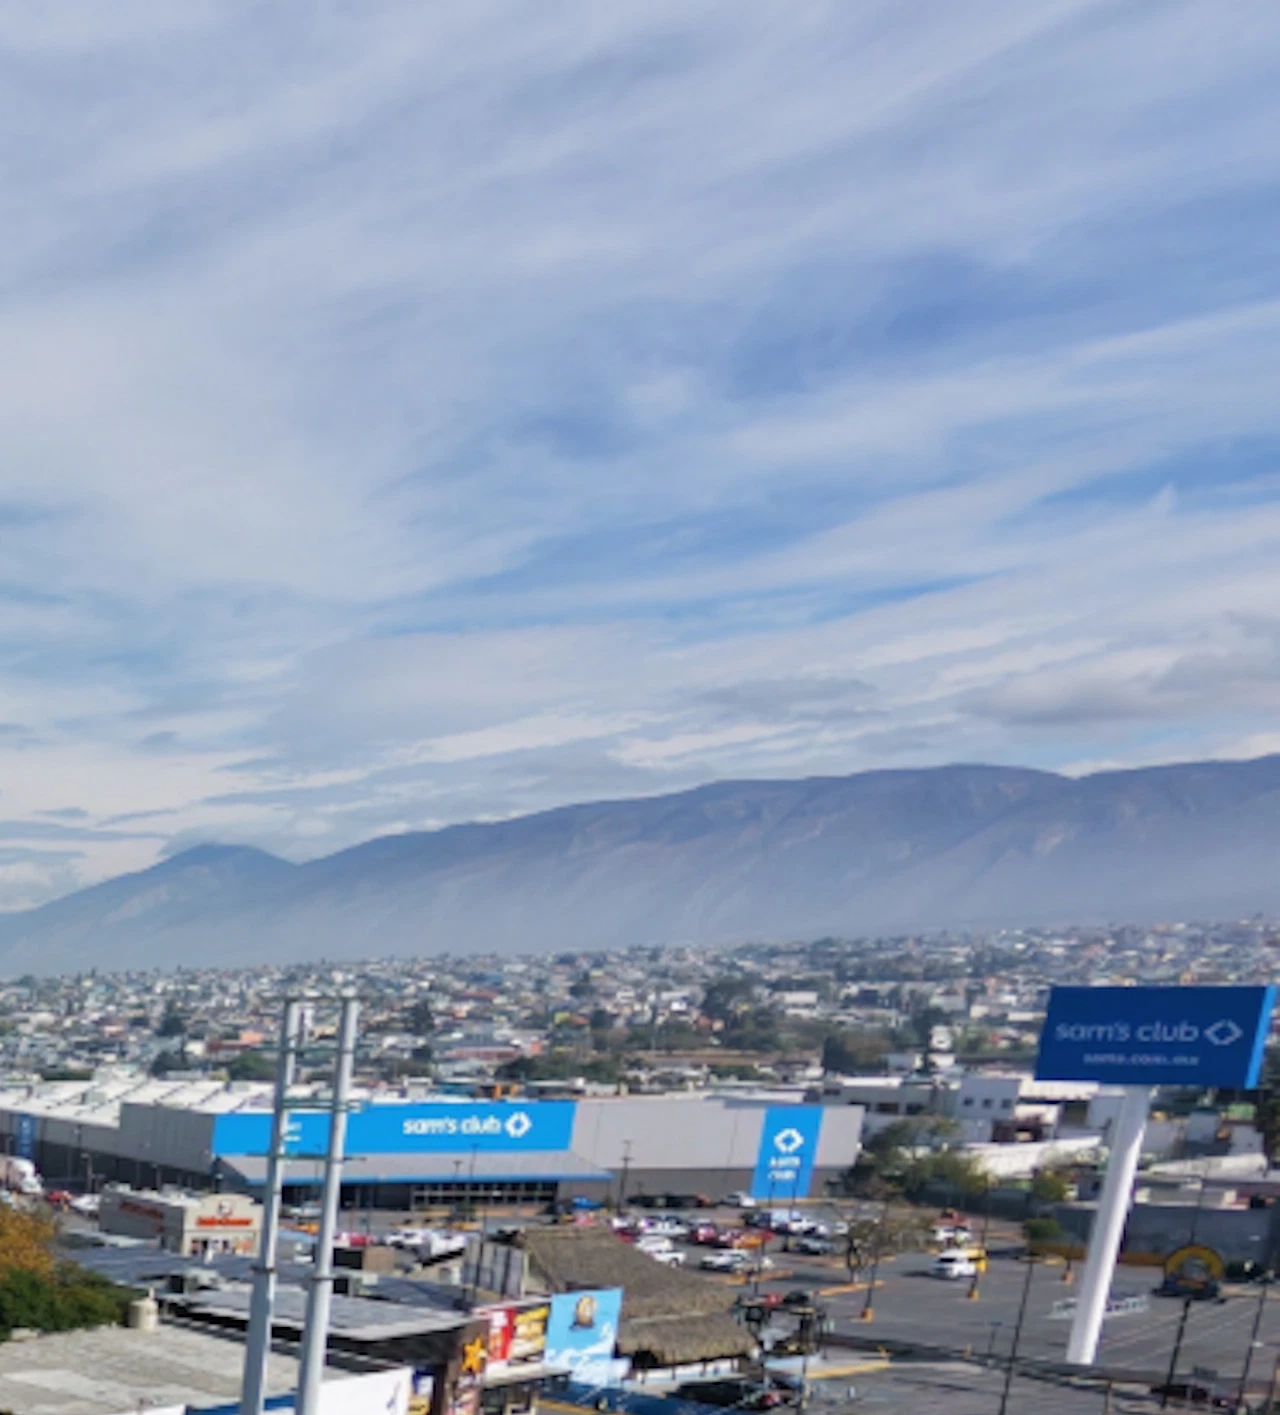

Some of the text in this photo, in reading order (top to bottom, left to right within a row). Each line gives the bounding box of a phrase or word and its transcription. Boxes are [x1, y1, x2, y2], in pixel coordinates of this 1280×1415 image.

[1055, 1019, 1199, 1042] sam's club
[403, 1114, 500, 1136] sam's club
